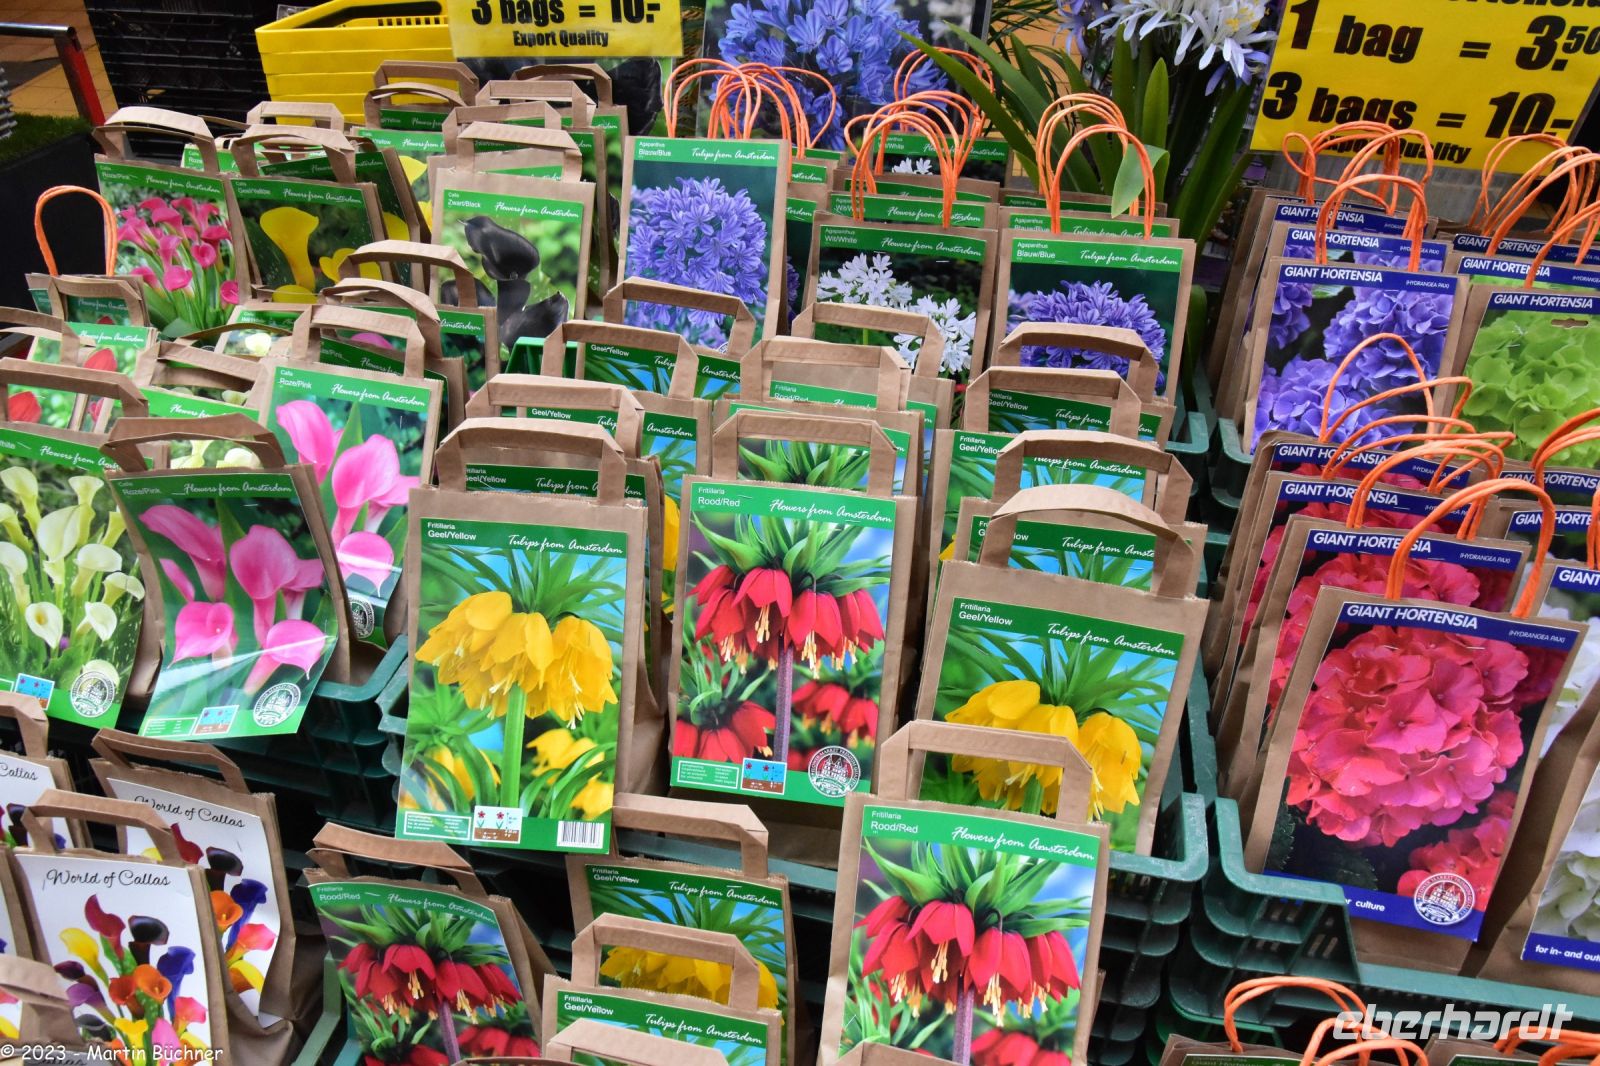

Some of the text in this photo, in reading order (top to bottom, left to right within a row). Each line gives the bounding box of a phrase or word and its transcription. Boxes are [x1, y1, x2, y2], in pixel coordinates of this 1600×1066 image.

[471, 0, 492, 25] 3
[501, 0, 565, 27] bags
[578, 5, 596, 18] =
[512, 30, 609, 48] Export Quality
[1290, 0, 1320, 50] 1
[1333, 15, 1423, 64] bag
[1459, 41, 1492, 59] =
[1261, 71, 1302, 120] 3
[1308, 87, 1418, 130] bags
[1435, 112, 1467, 129] =
[734, 152, 776, 161] Amsterdam
[1399, 138, 1472, 165] Quality
[1280, 206, 1309, 218] GIANT
[881, 237, 912, 249] Flowers
[935, 243, 982, 257] Amsterdam
[1291, 229, 1380, 249] GIAN HORTENSIA
[1457, 235, 1489, 249] GIANT
[1016, 249, 1179, 266] Blauw/Blue Tulips from Amsterdam
[1463, 258, 1493, 271] GIANT
[1285, 266, 1319, 279] GIANT
[1320, 269, 1383, 283] HORTENSIA
[1493, 292, 1594, 310] GIANT HORTENSIA
[382, 392, 425, 406] Amsterdam
[531, 408, 694, 437] Geel/Yellow Amsterdam
[1055, 408, 1082, 424] Tulips
[1279, 445, 1317, 458] GIANT
[1089, 459, 1143, 476] Amsterdam
[242, 482, 292, 494] Amsterdam
[535, 477, 565, 490] Tulips
[565, 481, 589, 493] from
[1545, 474, 1600, 489] HORTENSI
[1285, 483, 1399, 506] GIANT HORNSIA
[697, 496, 893, 524] Rood/Red Flowers from Amsterdam
[427, 521, 456, 531] Fritillaria
[427, 529, 624, 554] Geel/Yellow Tulips from Amsterdam
[1062, 535, 1095, 552] Tulips
[1093, 540, 1122, 556] from
[1313, 532, 1357, 547] GIANT
[1559, 569, 1600, 586] GIANT
[960, 602, 991, 613] Fritillaria
[1347, 605, 1395, 620] GIANT
[1395, 608, 1479, 630] HORTENSIA
[958, 610, 1176, 656] Geel/Yellow Tulips from Amsterdam
[184, 807, 197, 823] of
[198, 806, 247, 829] Callas
[871, 810, 902, 820] Fritillaria
[870, 820, 1095, 861] Rood/Red Flowers from Amsterdam
[46, 868, 172, 889] World of Callas
[668, 880, 699, 895] Tulips
[698, 885, 724, 899] from
[726, 888, 779, 907] Amsterdam
[422, 897, 447, 910] from
[1354, 899, 1386, 913] culture
[1535, 944, 1583, 959] for in- and
[564, 994, 593, 1005] Fritillaria
[564, 1002, 763, 1044] Geel/Yellow Tulips from Amsterdam
